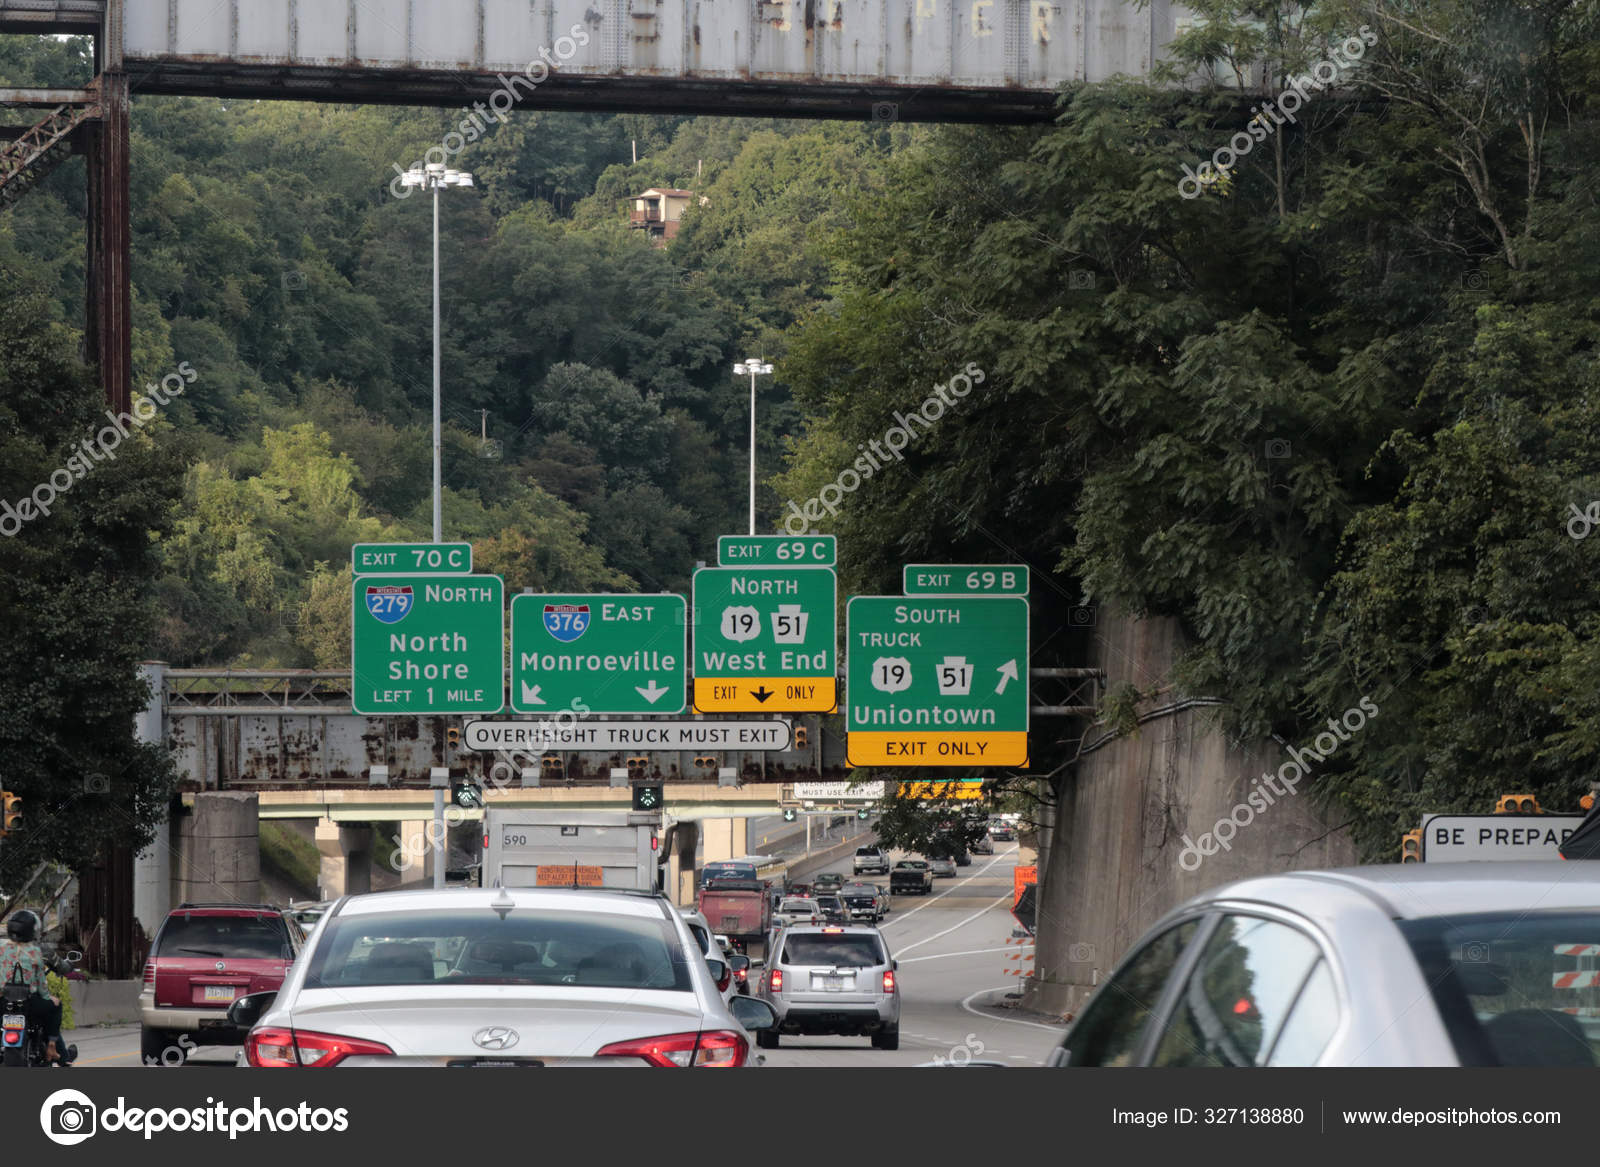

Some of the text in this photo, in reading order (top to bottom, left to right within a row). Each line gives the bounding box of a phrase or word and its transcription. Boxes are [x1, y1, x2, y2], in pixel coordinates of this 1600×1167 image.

[362, 552, 397, 566] EXIT
[728, 545, 762, 558] EXIT
[731, 577, 798, 595] NORTH
[917, 574, 951, 586] EXIT
[425, 585, 492, 602] NORTH
[371, 595, 409, 613] 279
[602, 603, 654, 621] EAST
[549, 614, 585, 631] 376
[895, 606, 960, 624] SOUTH
[731, 614, 754, 635] 19
[778, 615, 801, 636] 51
[390, 632, 468, 652] North
[859, 632, 922, 647] TRUCK
[521, 651, 676, 671] Monroeville
[703, 650, 827, 671] West End
[389, 660, 469, 680] Shore
[882, 665, 905, 686] 19
[943, 667, 966, 688] 51
[373, 688, 484, 705] LEFT 1 MILE
[714, 685, 815, 700] EXIT ONLY
[855, 704, 996, 725] Uniontown
[476, 728, 779, 743] OVERHEIGHT TRUCK MUST EXIT
[886, 741, 988, 756] EXIT ONLY
[504, 835, 527, 846] 590
[1436, 828, 1465, 845] BE
